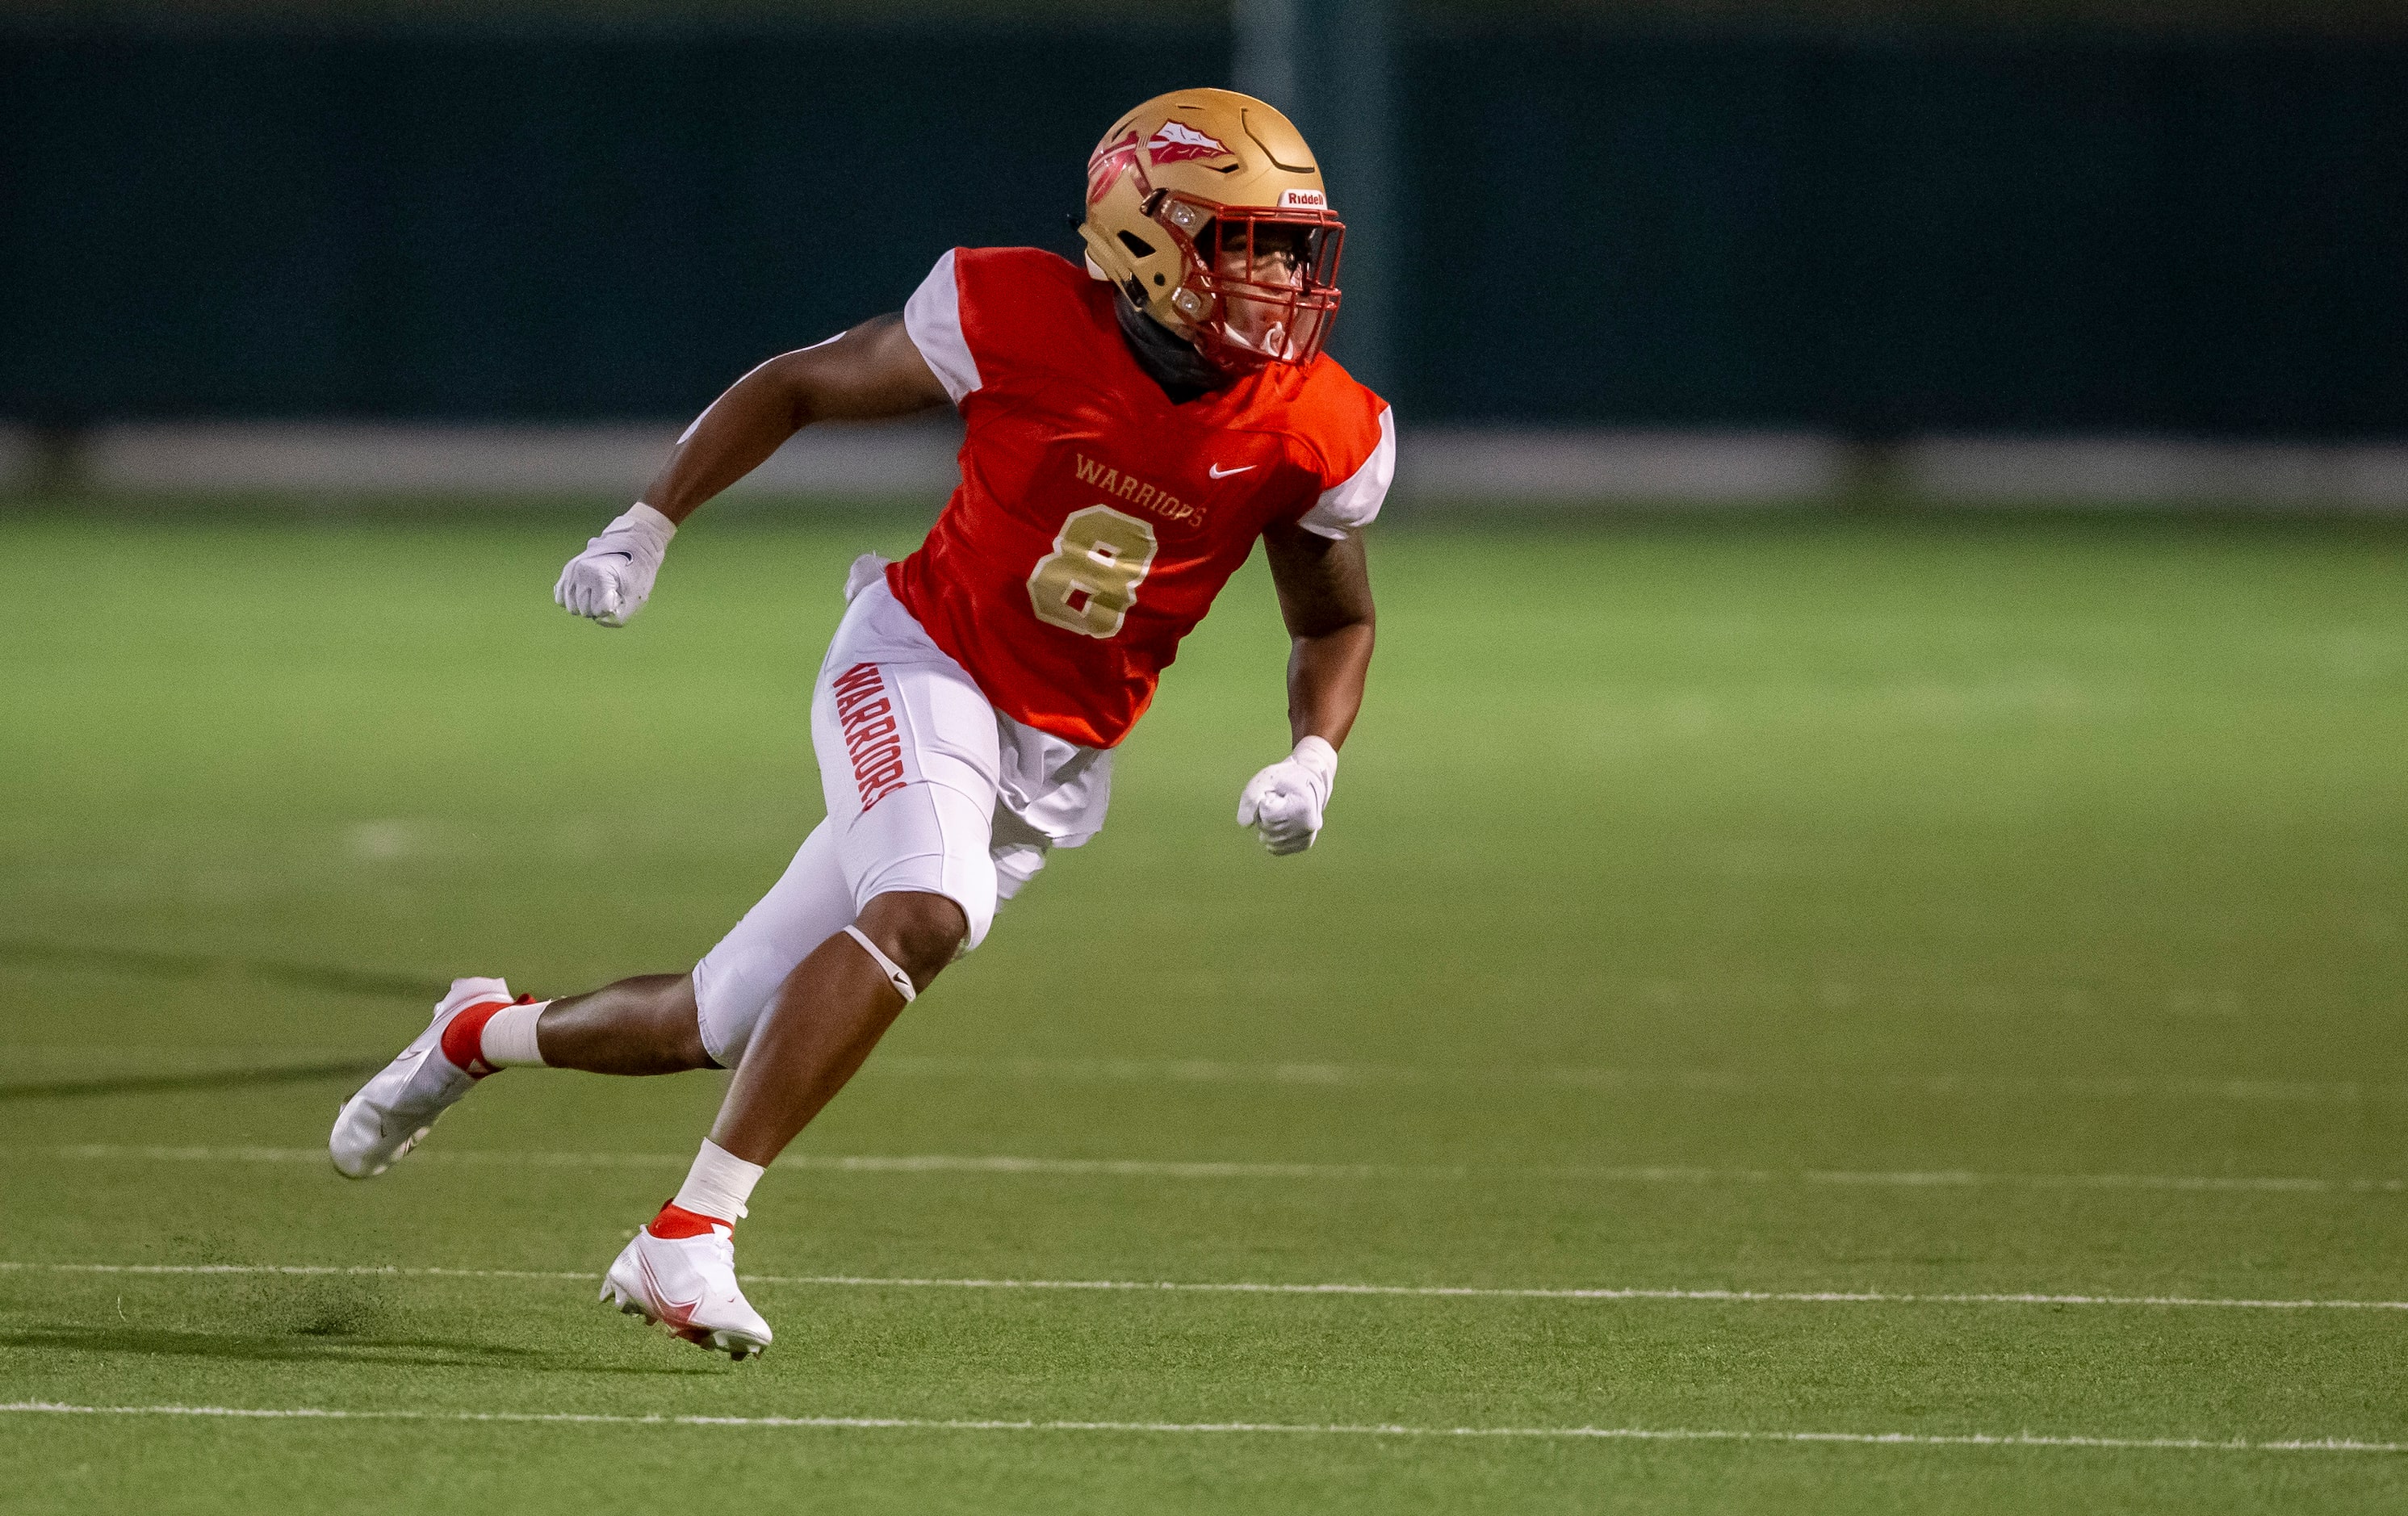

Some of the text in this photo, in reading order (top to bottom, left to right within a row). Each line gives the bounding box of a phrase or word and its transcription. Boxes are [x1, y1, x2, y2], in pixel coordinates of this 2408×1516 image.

[1288, 192, 1324, 205] Riddell
[1075, 452, 1208, 528] WARRIORS
[1026, 504, 1158, 639] 8
